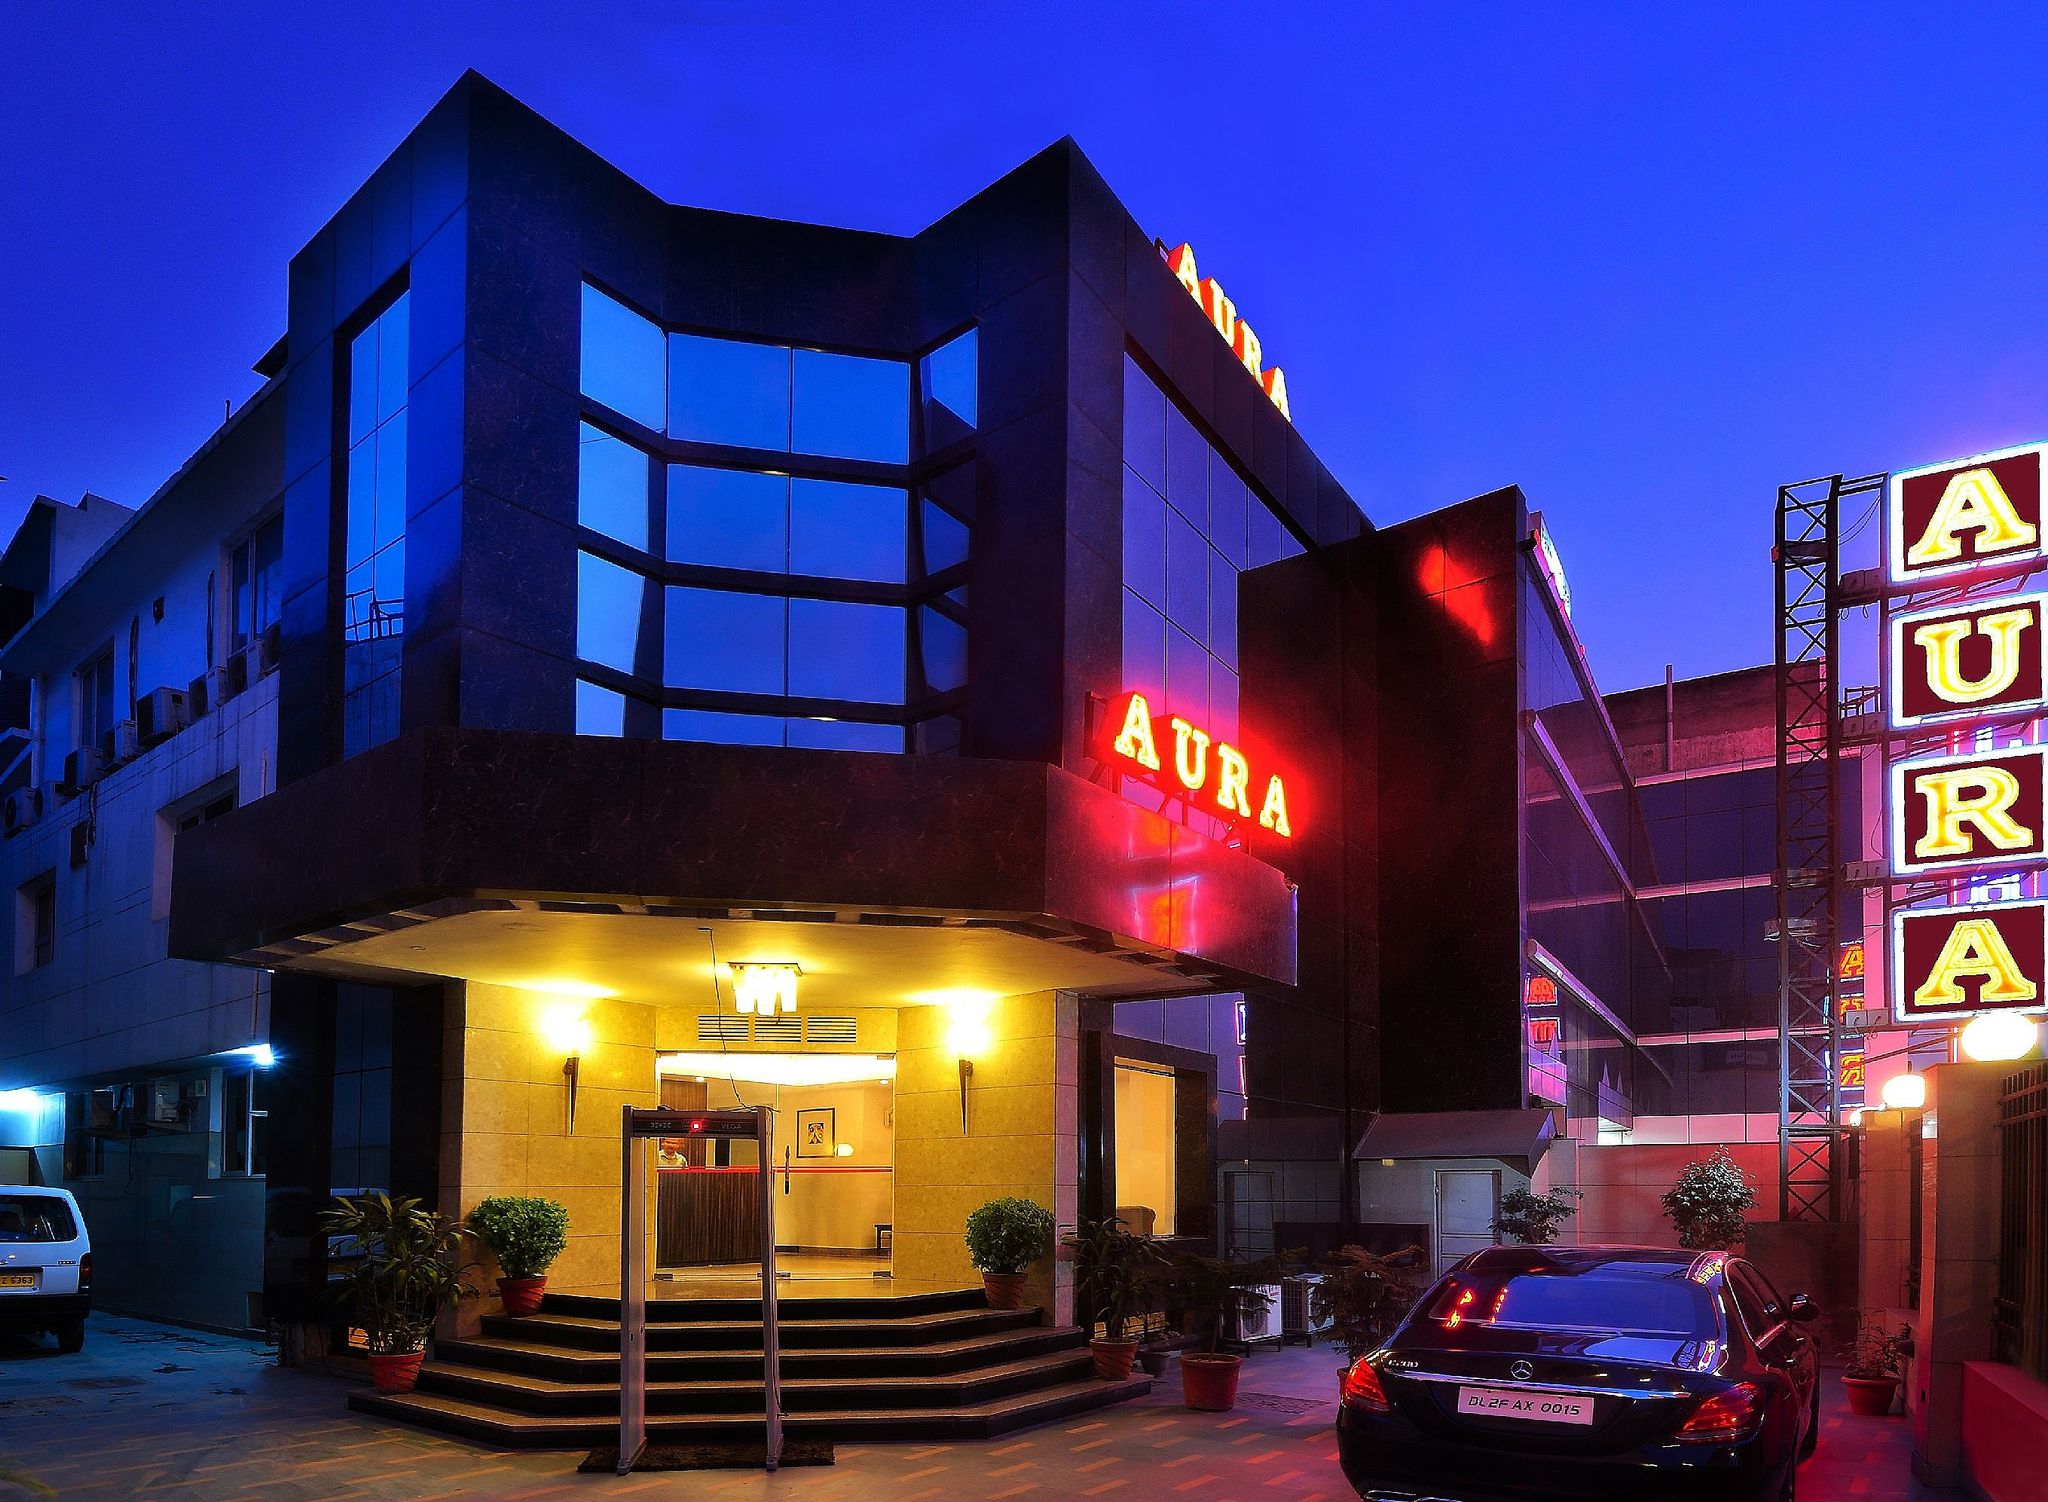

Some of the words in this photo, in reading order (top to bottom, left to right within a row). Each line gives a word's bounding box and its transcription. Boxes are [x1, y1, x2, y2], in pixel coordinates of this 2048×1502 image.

[1176, 243, 1291, 422] AURA
[1114, 694, 1290, 837] AURA
[1907, 467, 2037, 1006] AURA
[1511, 1401, 1534, 1412] AX
[1540, 1404, 1581, 1416] 0015
